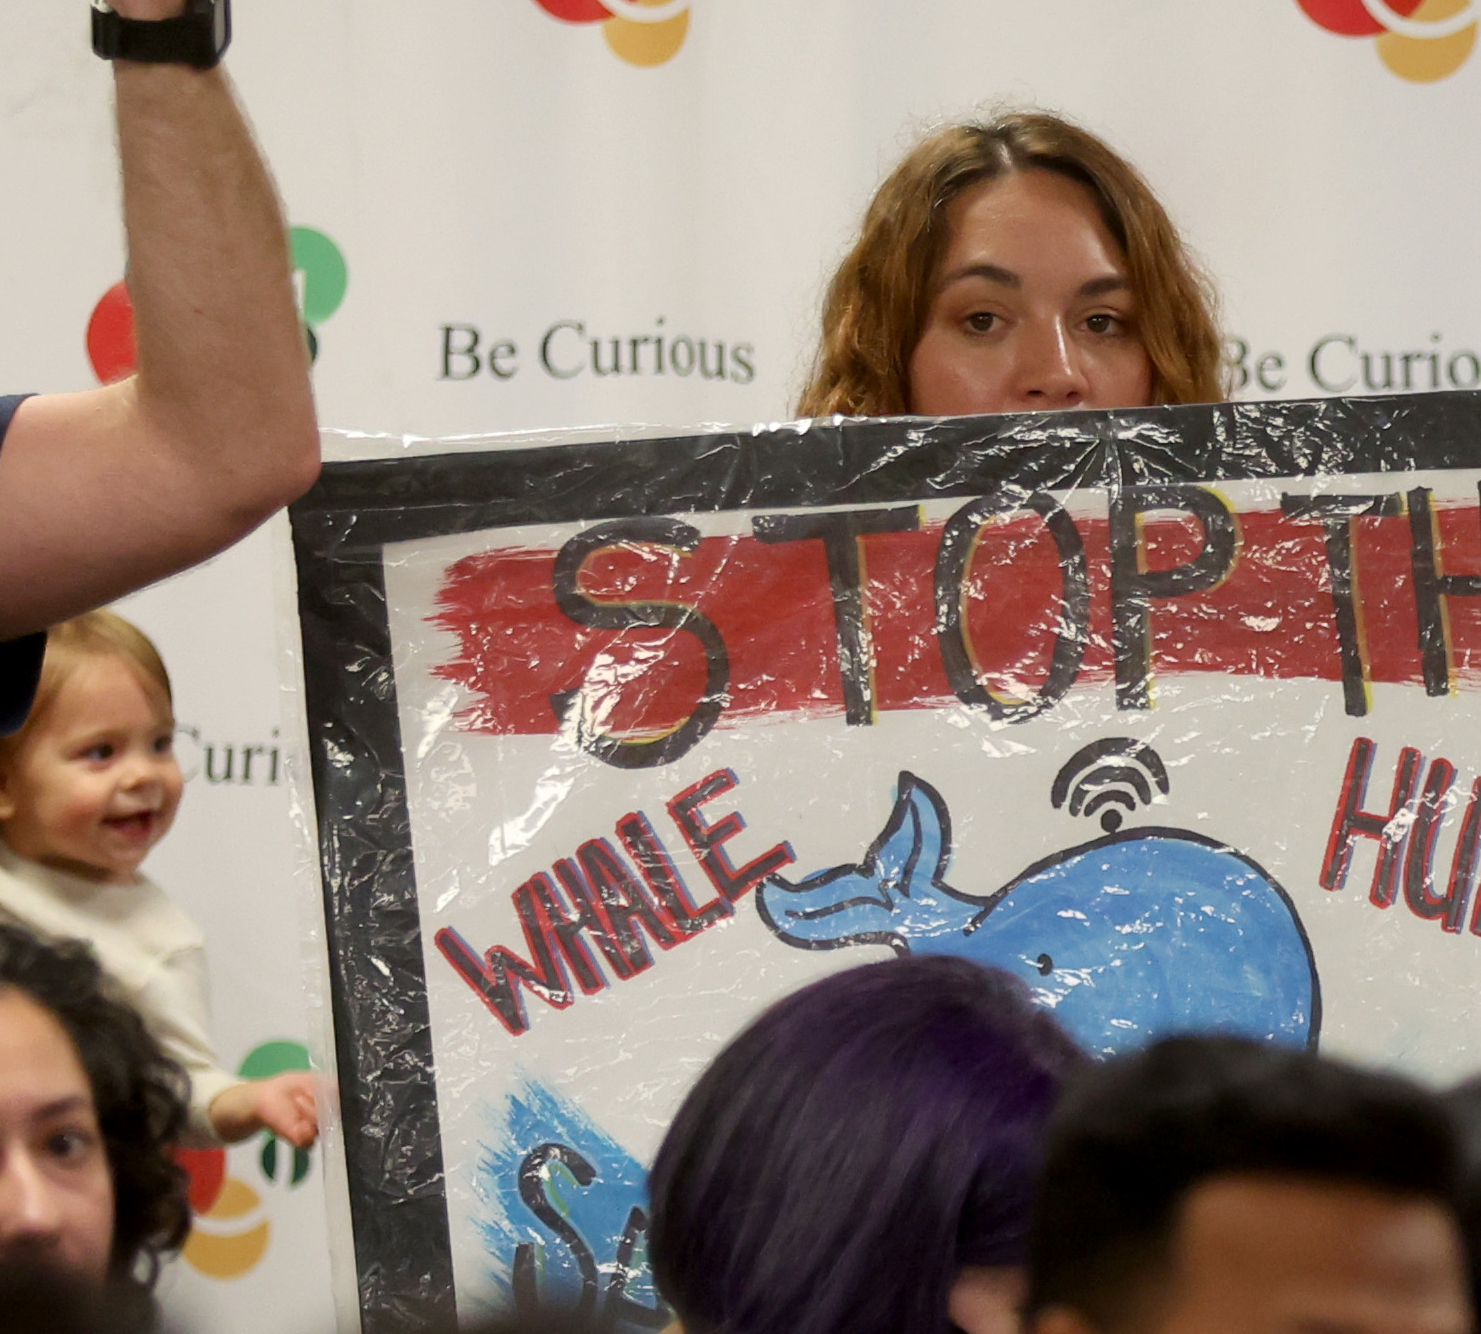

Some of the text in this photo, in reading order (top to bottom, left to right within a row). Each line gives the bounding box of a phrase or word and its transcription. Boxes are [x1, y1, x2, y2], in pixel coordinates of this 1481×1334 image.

[439, 316, 757, 385] Be Curious
[550, 482, 1243, 770] STOP
[433, 768, 796, 1035] WHALE
